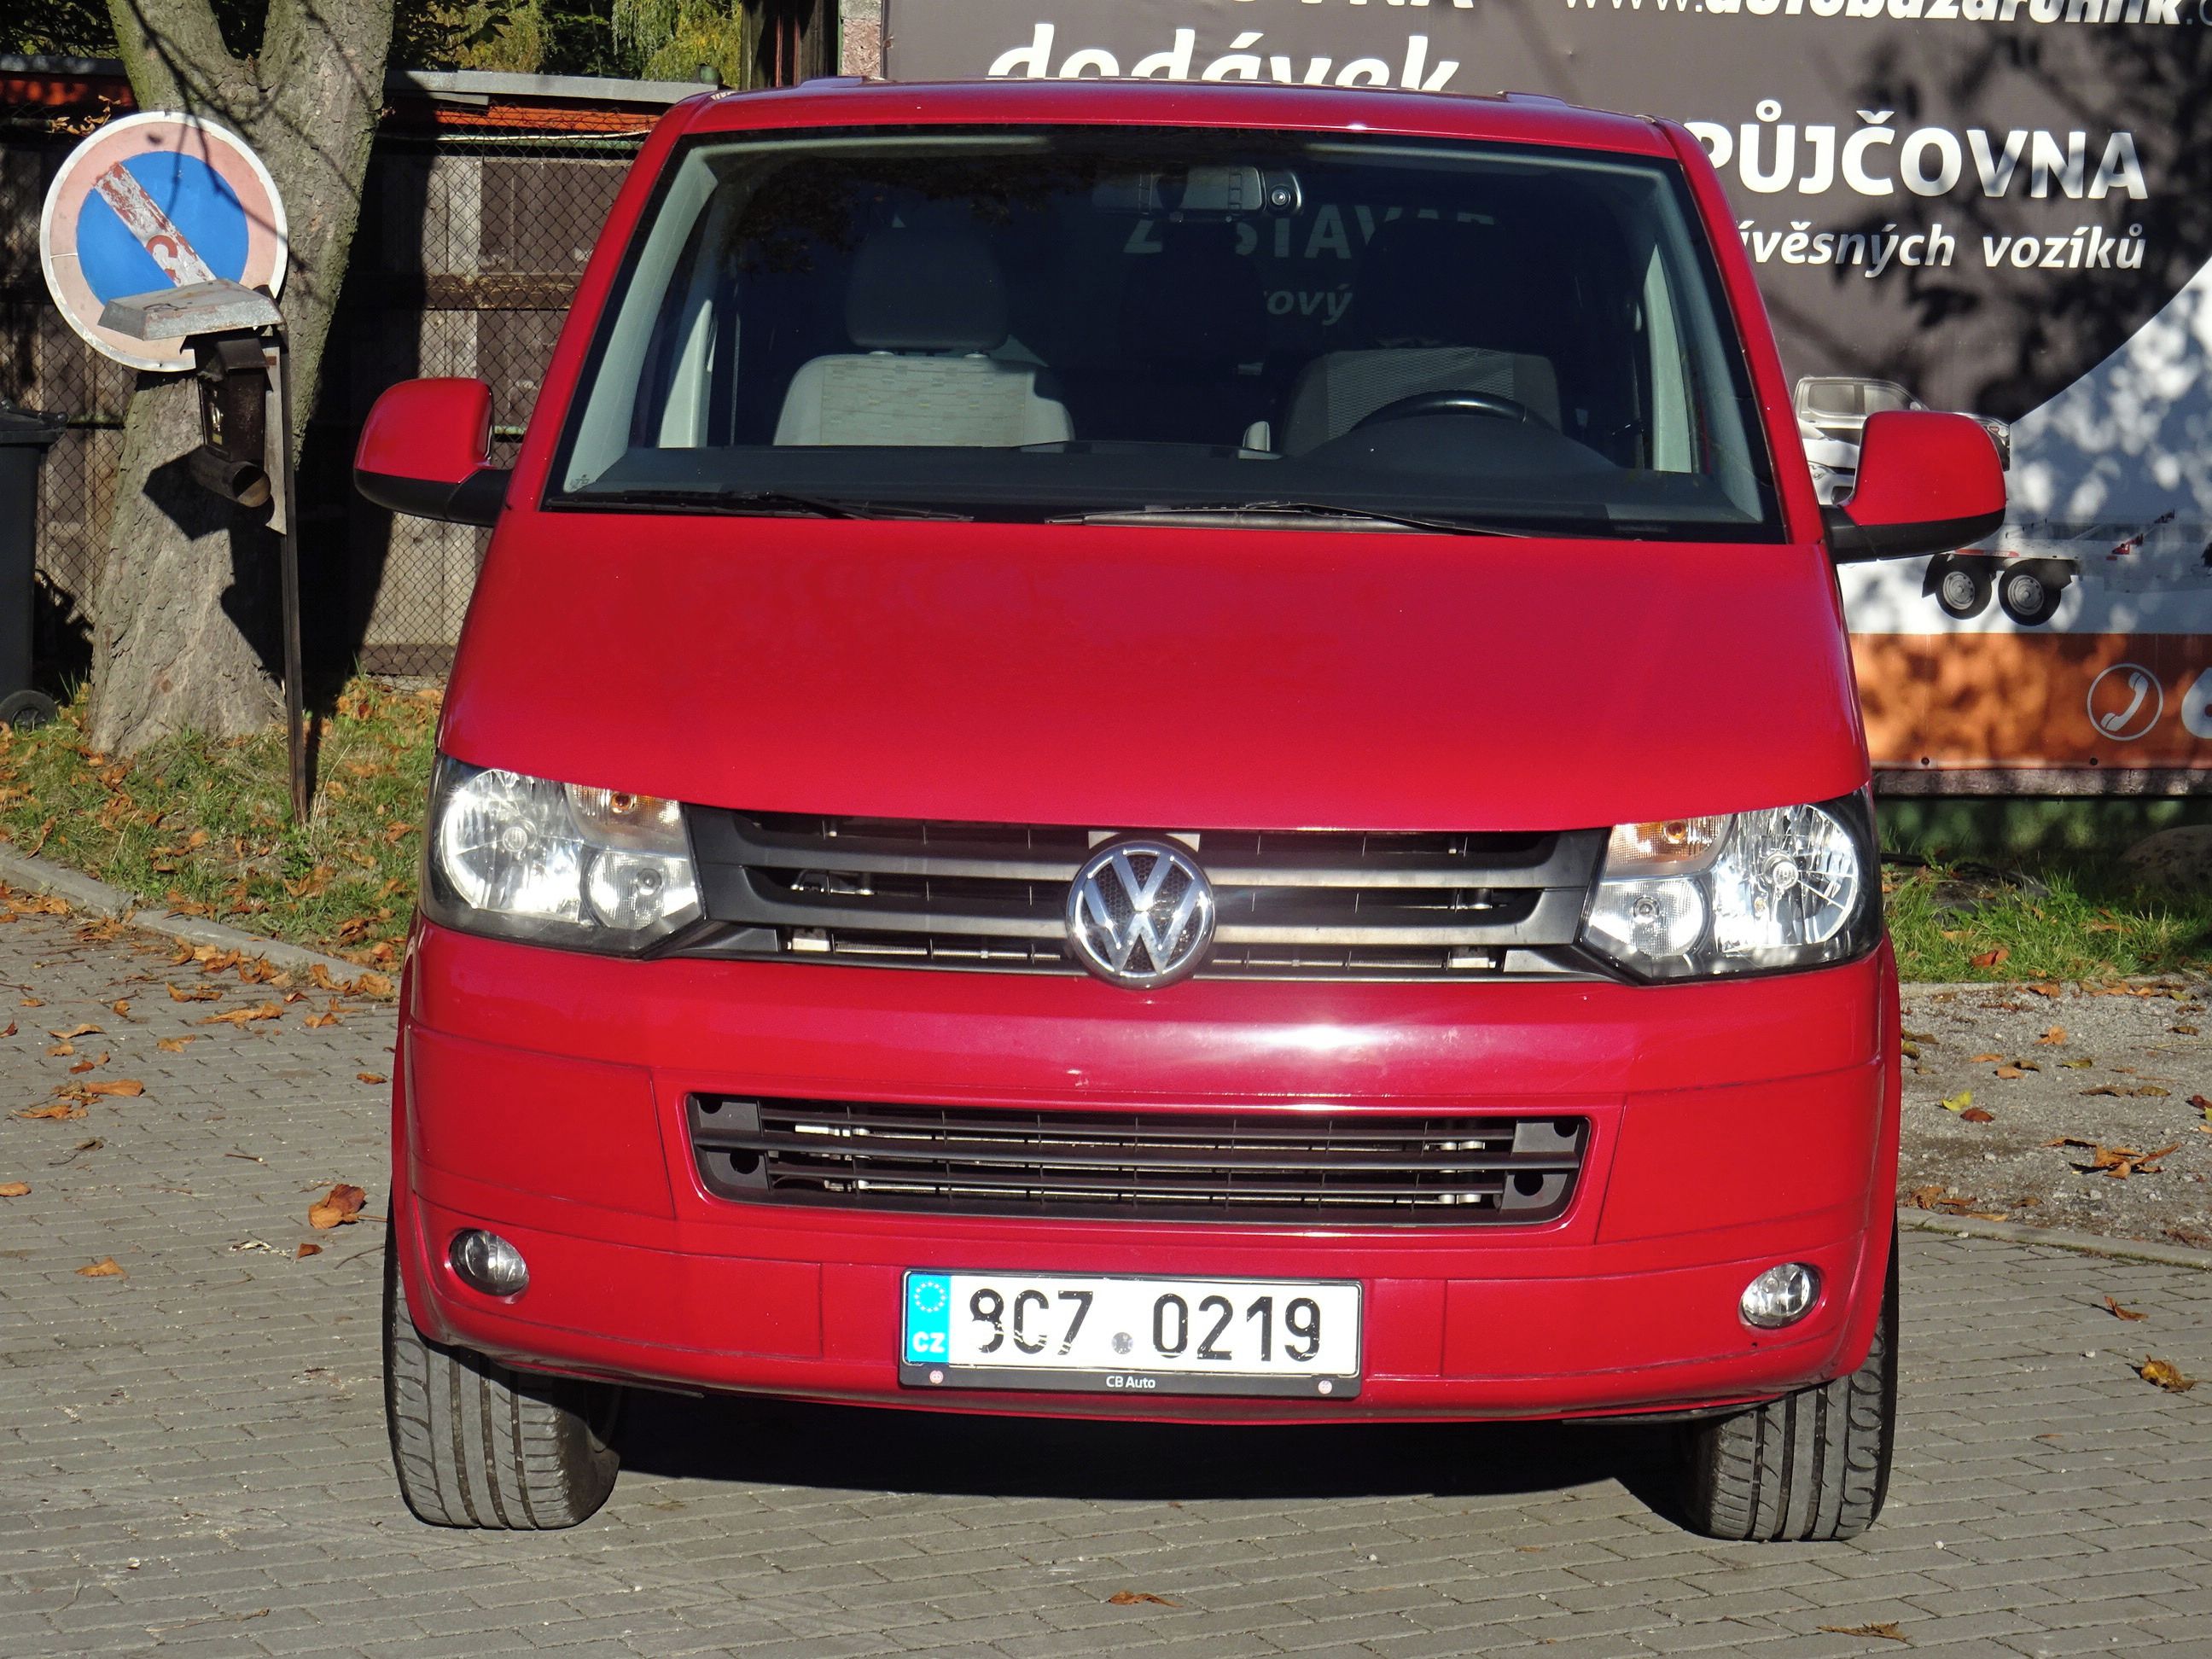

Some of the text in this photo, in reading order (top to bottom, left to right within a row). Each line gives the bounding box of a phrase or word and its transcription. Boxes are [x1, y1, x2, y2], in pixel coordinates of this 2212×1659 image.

[988, 23, 1460, 91] dodávek
[1683, 99, 2149, 201] PŮJČOVNA
[1738, 218, 2148, 278] ívěsných vozíků
[1263, 283, 1353, 326] ový
[912, 1330, 946, 1353] CZ
[1152, 1293, 1321, 1363] 0219
[1105, 1375, 1156, 1389] CB Auto
